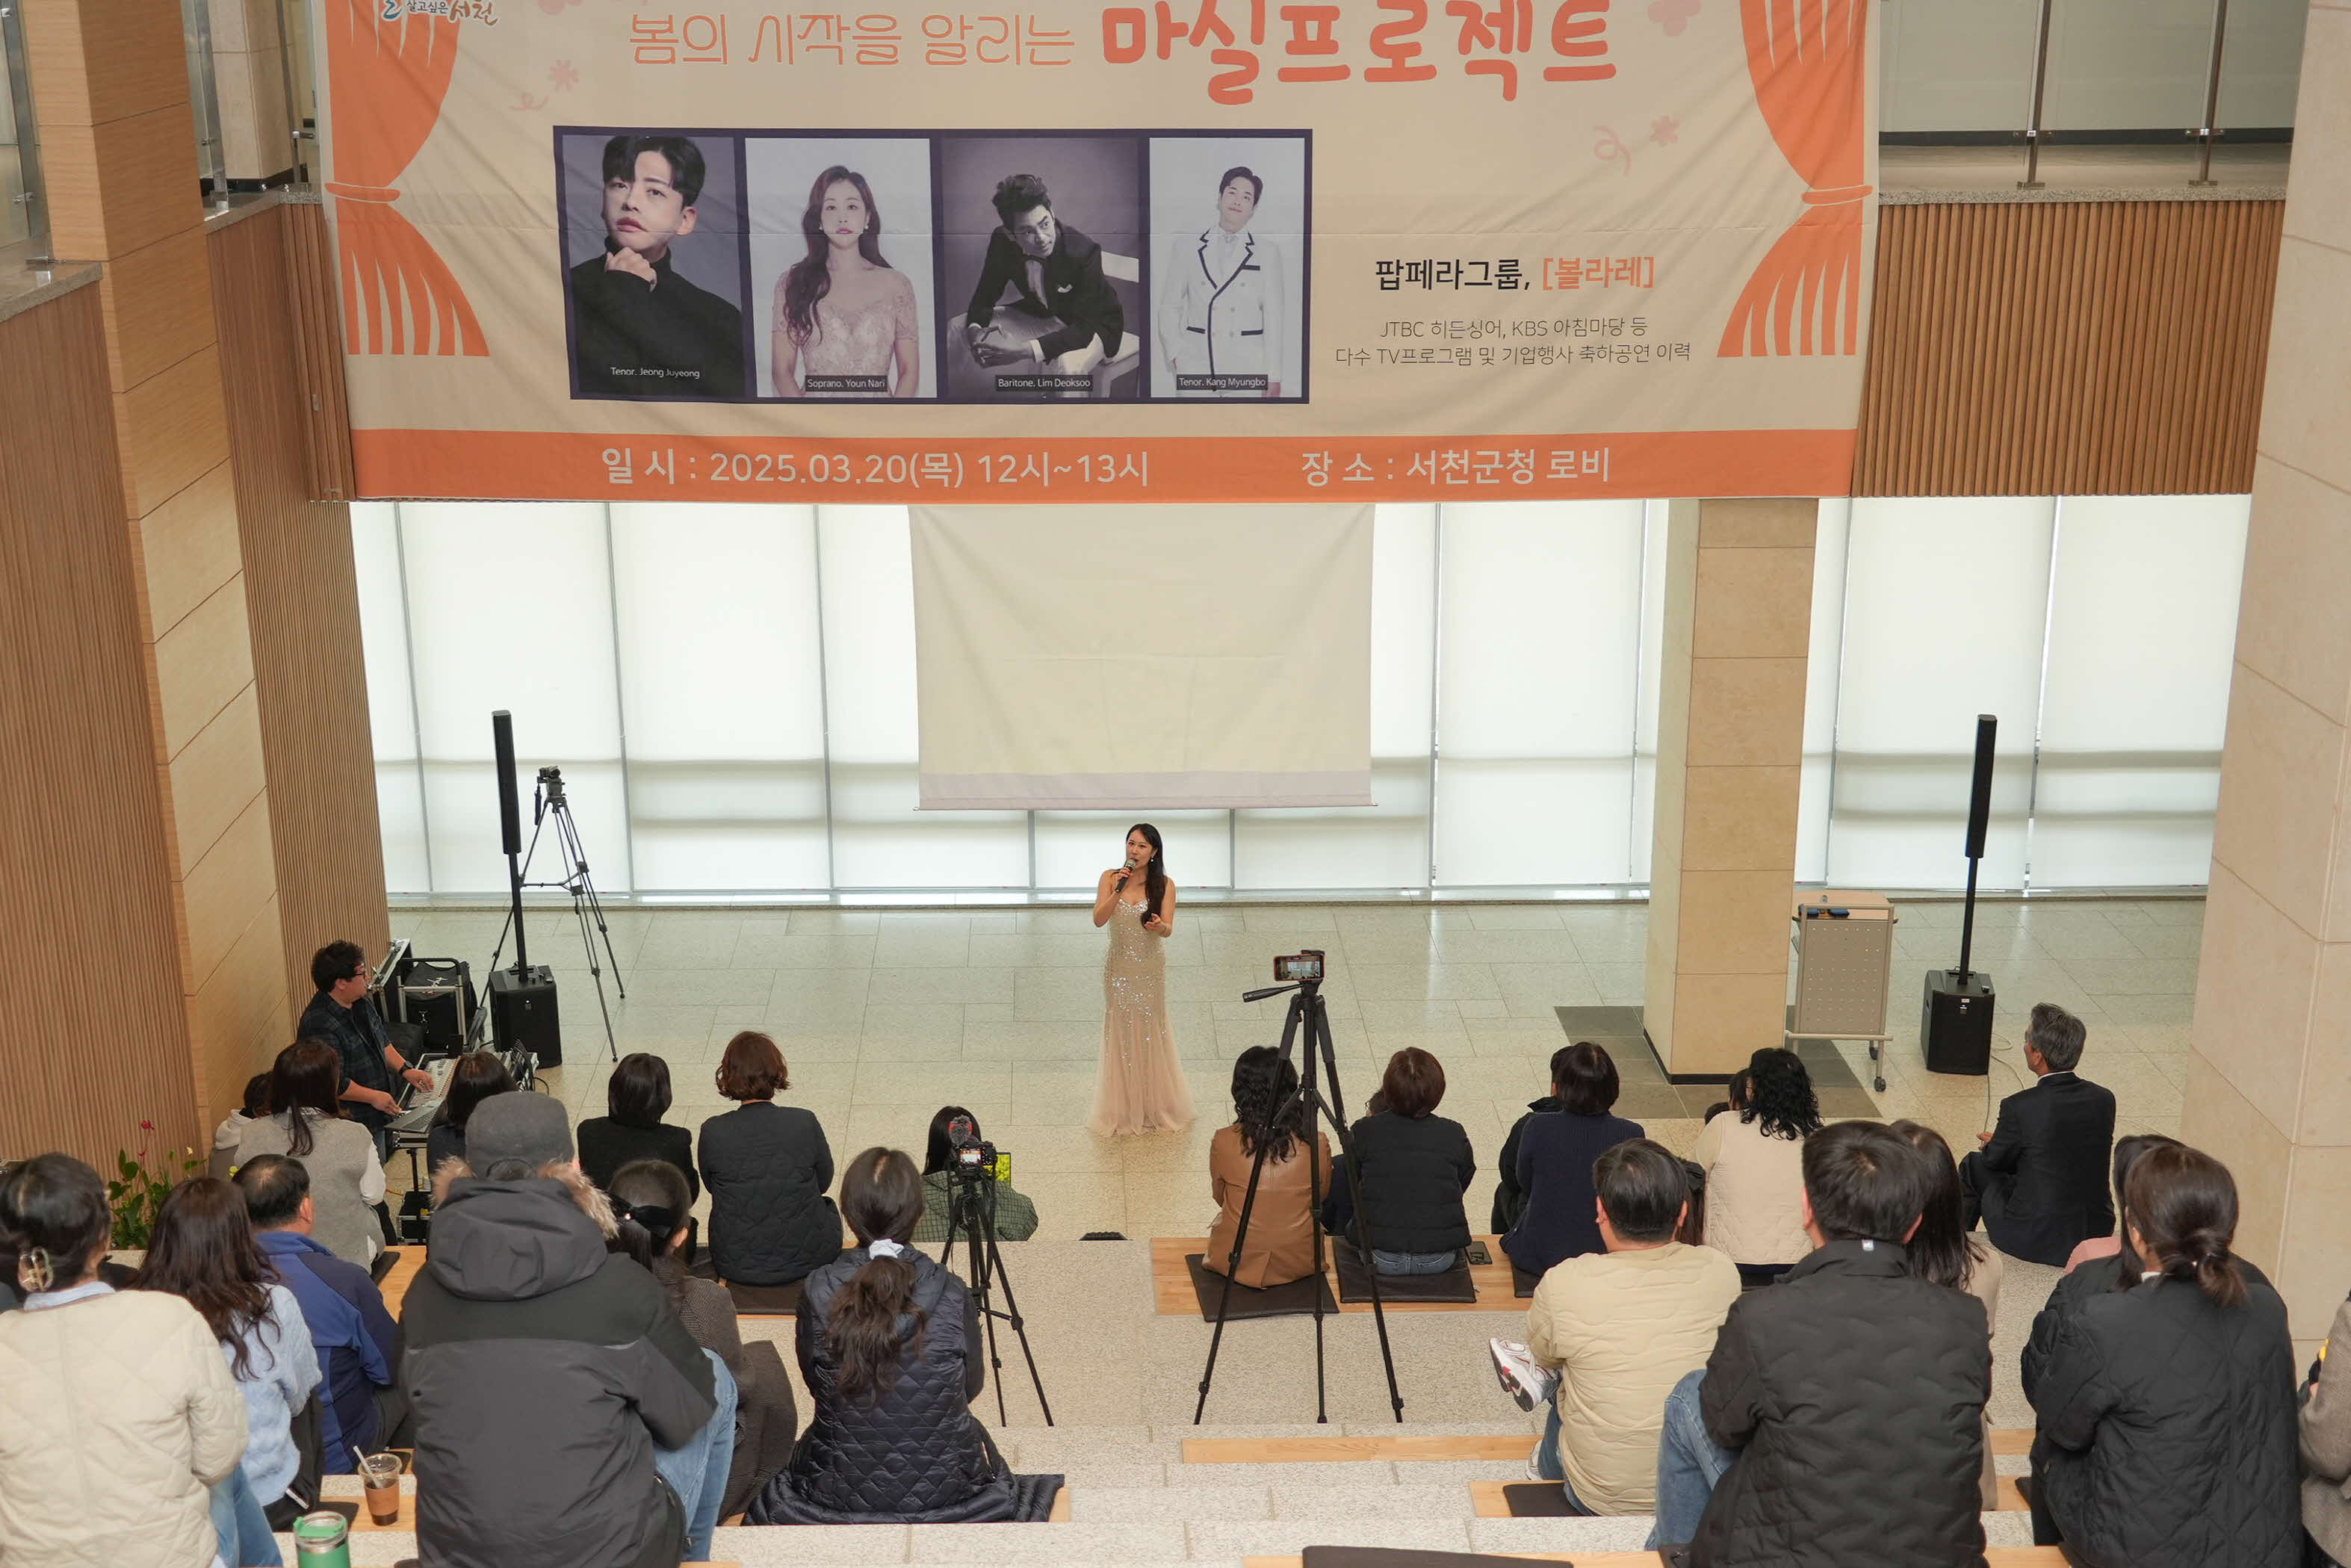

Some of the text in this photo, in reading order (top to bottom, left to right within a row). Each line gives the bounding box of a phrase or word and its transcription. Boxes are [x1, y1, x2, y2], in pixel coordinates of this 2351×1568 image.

[628, 0, 1617, 105] 봄의 시작을 알리는 마실프로젝트
[1375, 256, 1655, 291] 팝페라그룹, [볼라레]
[1380, 317, 1648, 340] JTBC 히든싱어, KBS 아침마당 등
[1336, 342, 1691, 367] 다수 TV프로그램 및 기업행사 축하공연 이력
[610, 367, 700, 380] Tenor. Jeong Juyeong
[808, 379, 885, 389] Soprano. Youn Nari
[998, 378, 1091, 388] Baritone. Lim Deoksoo
[1179, 377, 1266, 389] Tenor. Kang Myungbo
[602, 448, 634, 484] 일
[645, 448, 675, 485] 시
[710, 452, 964, 487] 2025.03.20(목)
[978, 451, 1147, 486] 12시~13시
[1301, 451, 1334, 487] 장
[1342, 453, 1375, 481] 소
[1406, 449, 1536, 485] 서천군청
[1546, 447, 1609, 483] 로비
